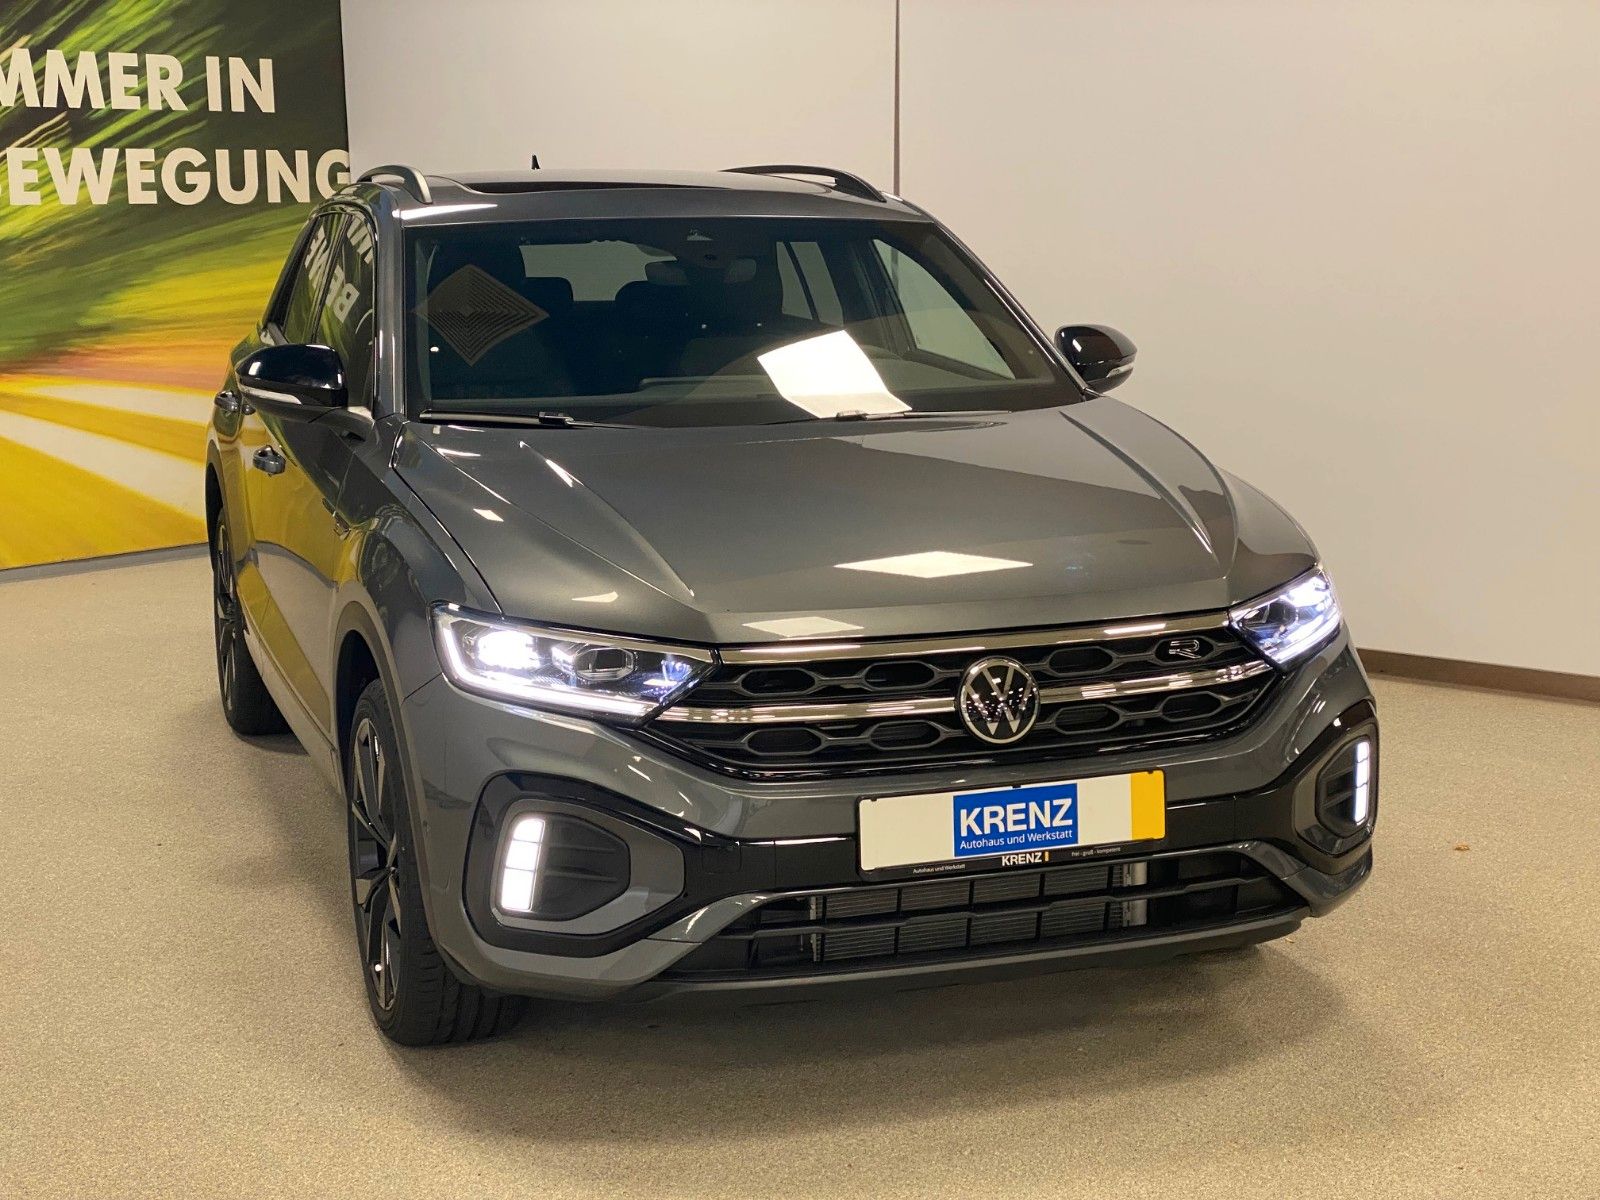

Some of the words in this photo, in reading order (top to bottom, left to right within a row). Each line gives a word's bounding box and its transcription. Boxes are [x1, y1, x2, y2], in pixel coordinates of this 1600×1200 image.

[205, 56, 275, 113] IN
[0, 147, 350, 206] EWEGUNG
[960, 798, 1073, 837] KRENZ
[960, 838, 1005, 850] Autohaus
[1007, 833, 1025, 845] und
[1027, 830, 1073, 842] Werkstatt
[1001, 851, 1042, 867] KRENZ
